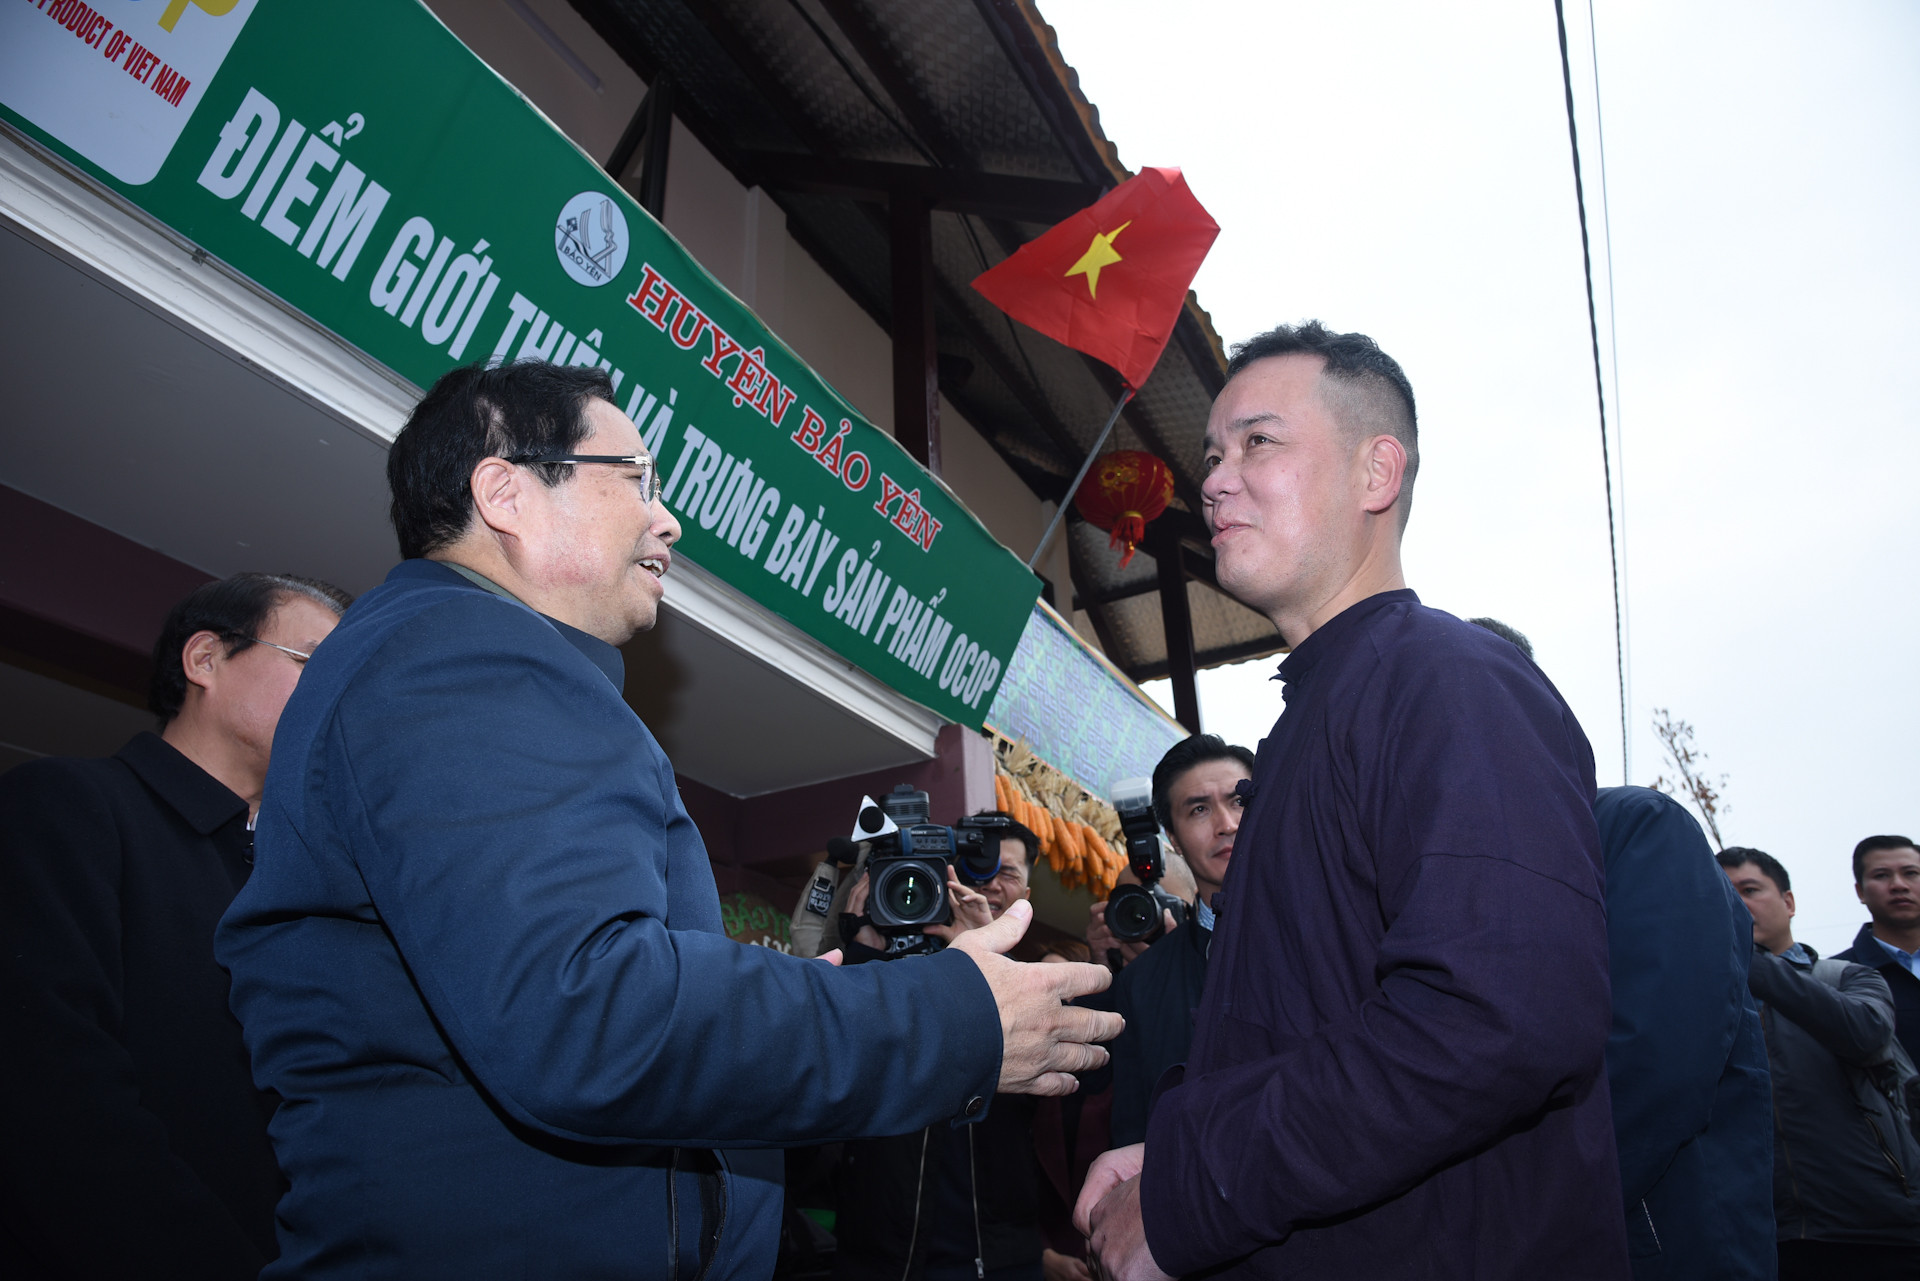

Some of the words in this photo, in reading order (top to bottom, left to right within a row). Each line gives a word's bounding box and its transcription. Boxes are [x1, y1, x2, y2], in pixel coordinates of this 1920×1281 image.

[104, 29, 132, 63] OF
[123, 42, 161, 84] VIET
[150, 63, 191, 108] NAM
[196, 86, 392, 283] ĐIỂM
[369, 216, 501, 361] GIỚI
[661, 423, 781, 560] TRƯNG
[763, 504, 840, 597] BÀY
[822, 540, 891, 636] SẢN
[873, 587, 953, 679] PHẨM
[938, 633, 1001, 710] OCOP
[627, 262, 797, 428] HUYỆN
[790, 404, 871, 491] BẢO
[873, 473, 942, 552] YÊN
